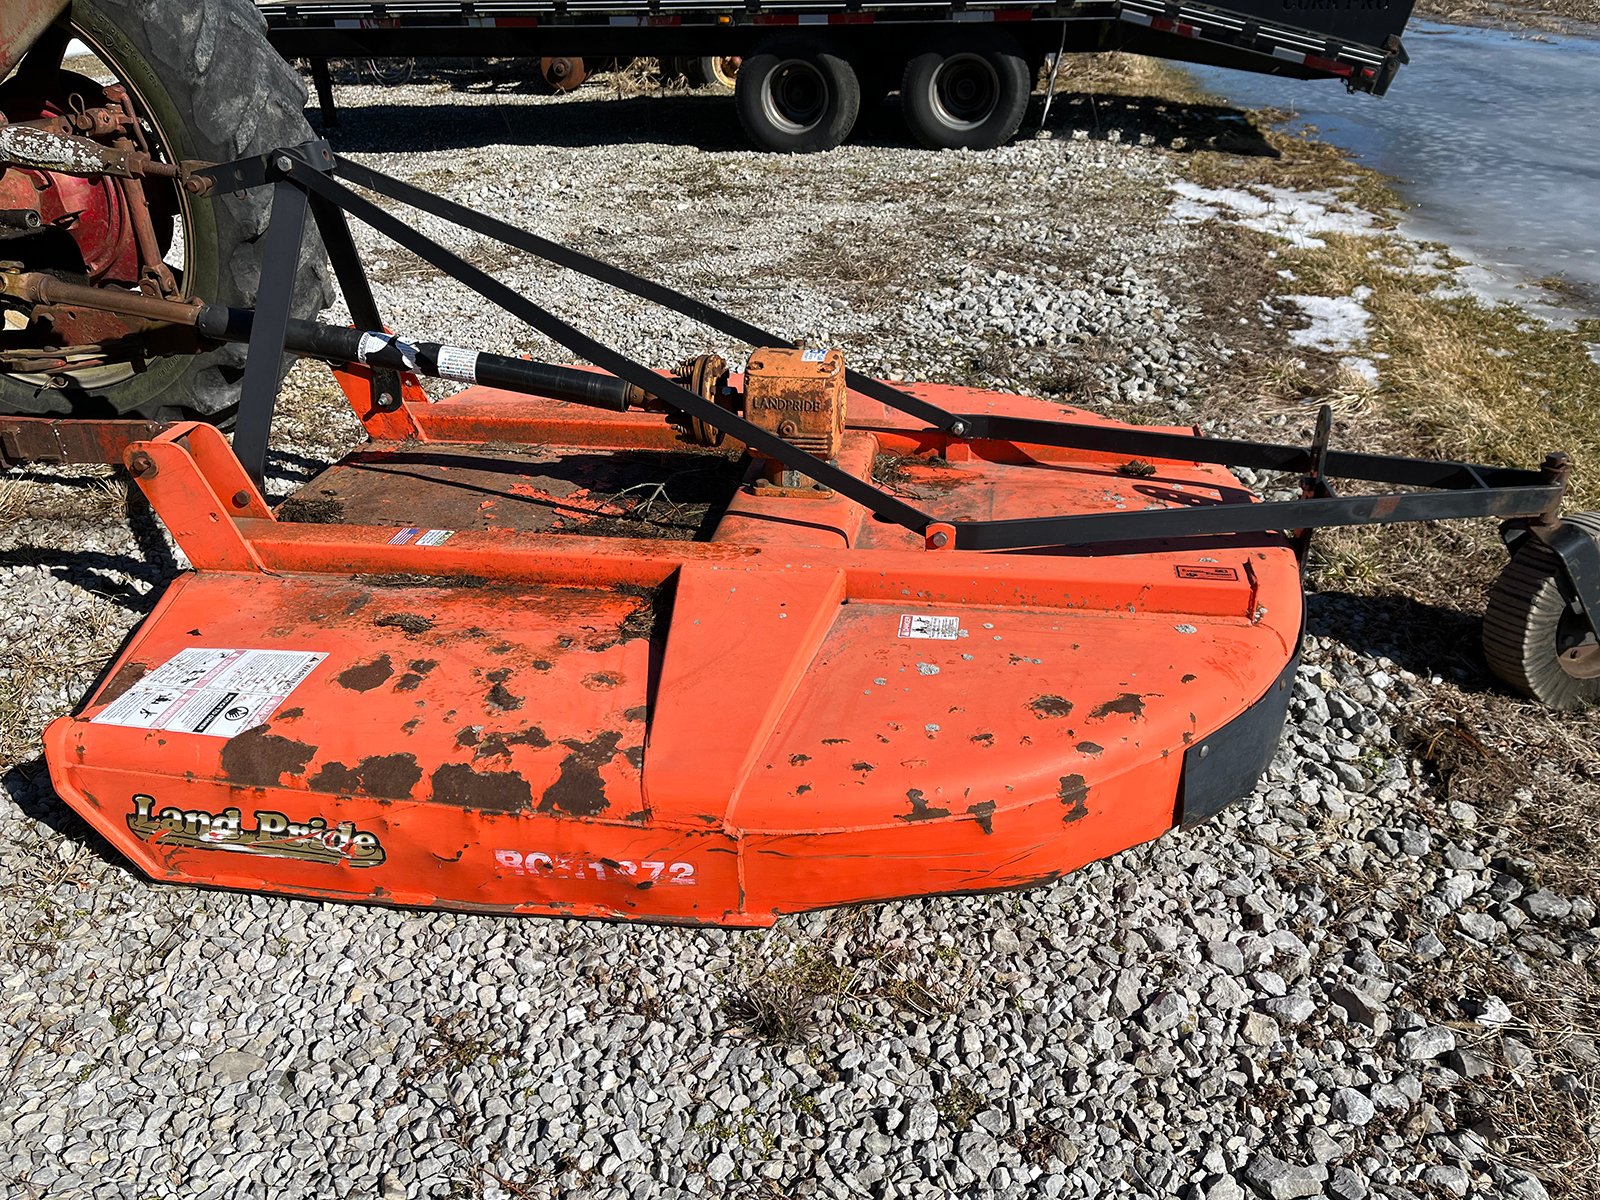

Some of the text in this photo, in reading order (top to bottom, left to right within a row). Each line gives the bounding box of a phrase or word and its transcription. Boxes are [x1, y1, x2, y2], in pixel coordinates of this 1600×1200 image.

[752, 396, 821, 413] LANDPRIDE
[132, 793, 379, 857] Land Pride
